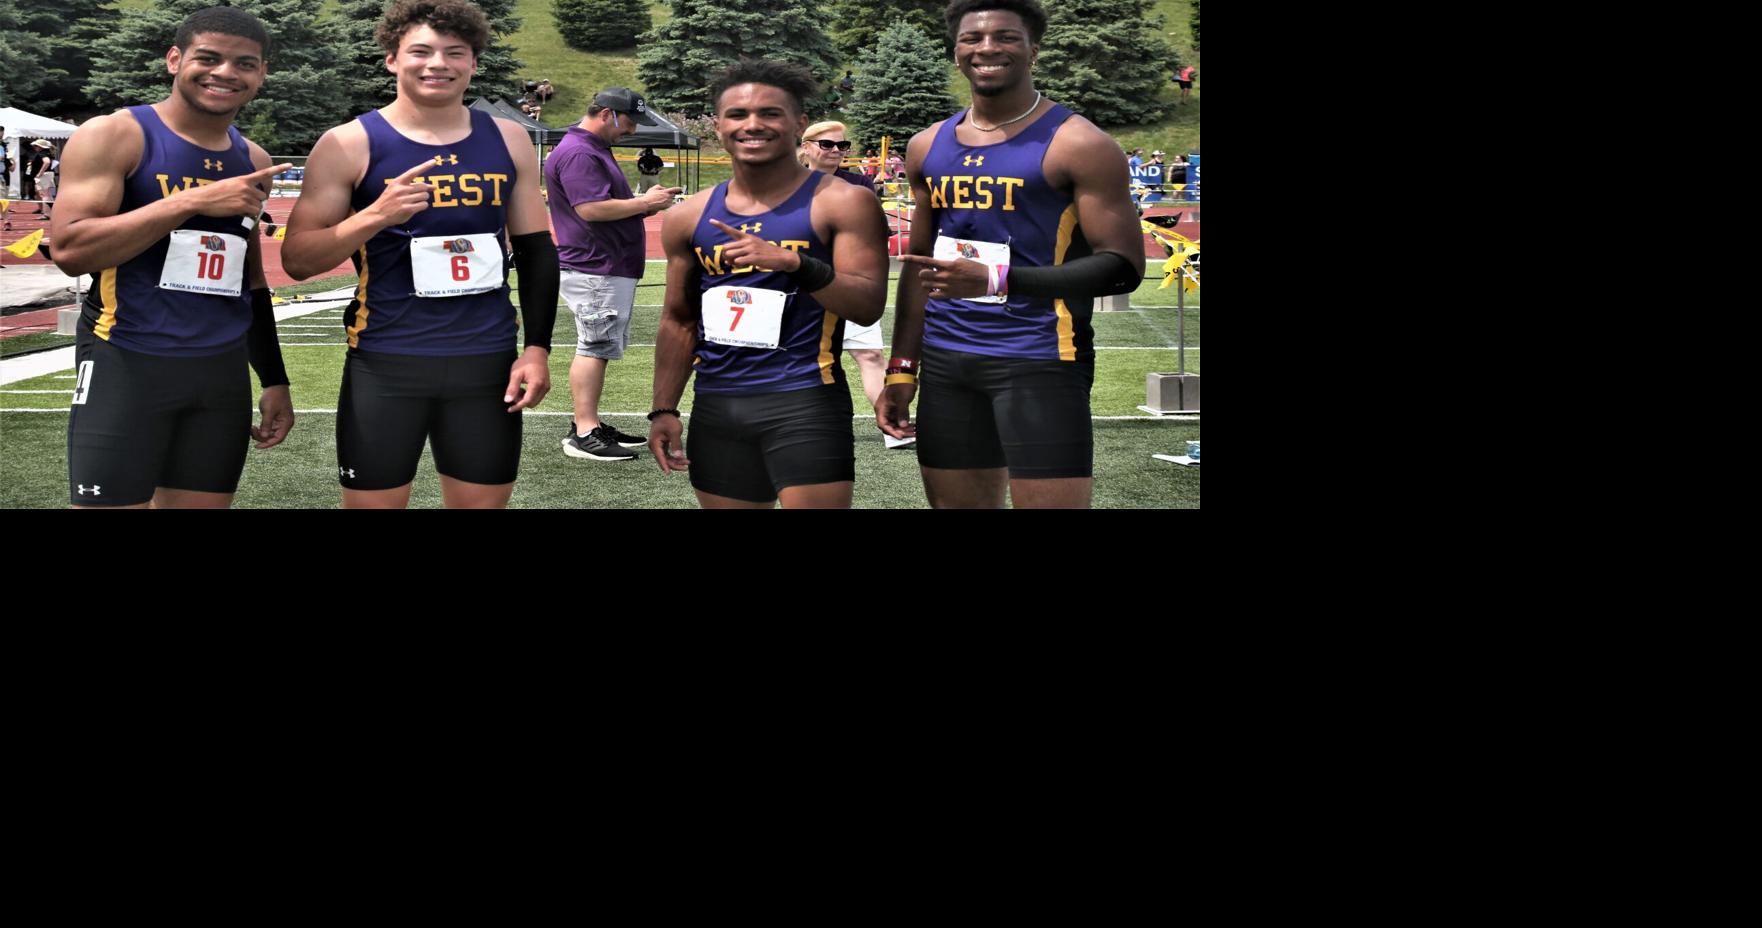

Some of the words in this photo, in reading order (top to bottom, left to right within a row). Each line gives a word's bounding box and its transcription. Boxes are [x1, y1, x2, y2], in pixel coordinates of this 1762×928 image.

[384, 173, 508, 208] EST
[925, 175, 1024, 211] WEST
[197, 252, 225, 280] 10
[450, 255, 470, 281] 6
[694, 240, 809, 276] WT
[729, 306, 745, 332] 7
[900, 359, 912, 368] N
[76, 364, 87, 401] 4
